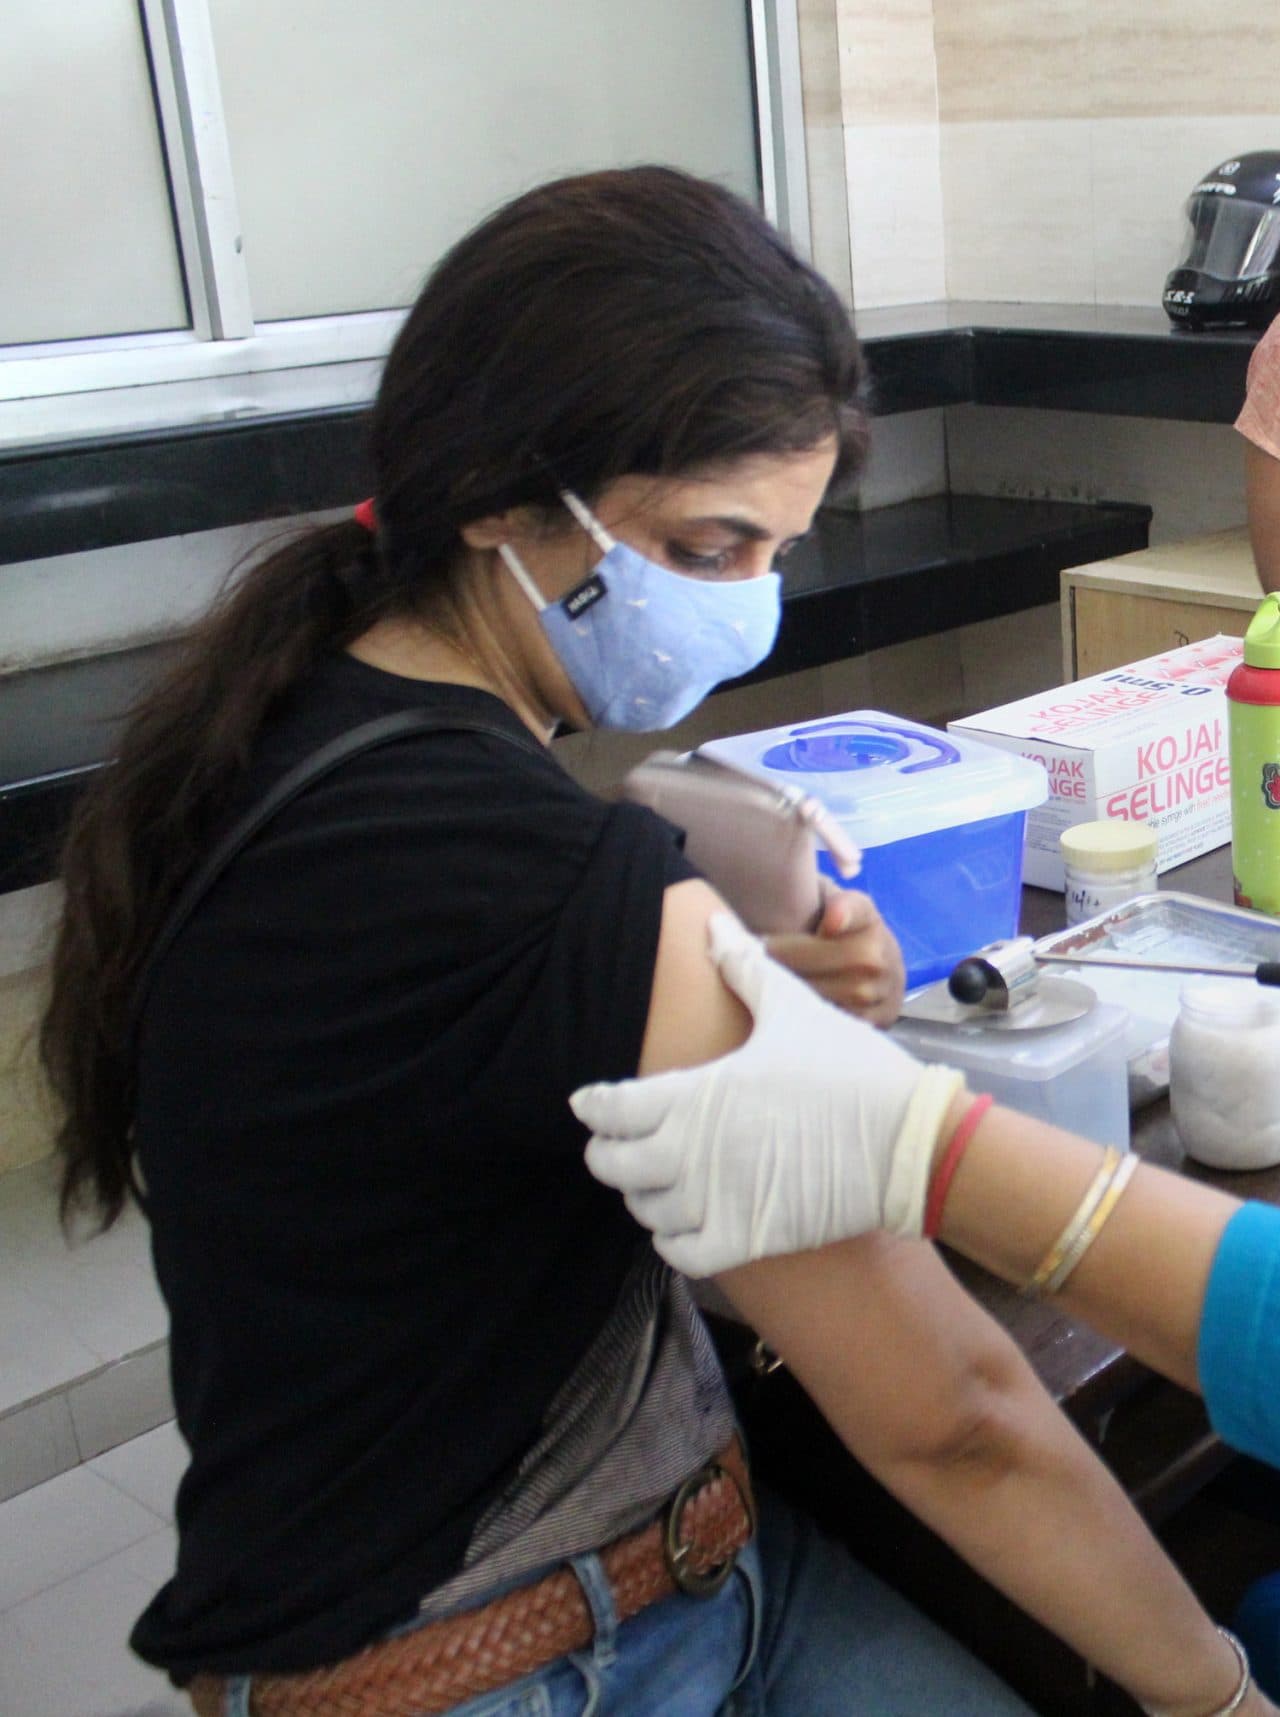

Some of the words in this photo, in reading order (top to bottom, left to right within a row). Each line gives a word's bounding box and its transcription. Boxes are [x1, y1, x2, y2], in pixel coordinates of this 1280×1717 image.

[1029, 686, 1138, 720] KOJAK
[1030, 691, 1169, 734] SELINGE
[1022, 752, 1084, 779] JAK
[1107, 757, 1231, 822] SELINGE
